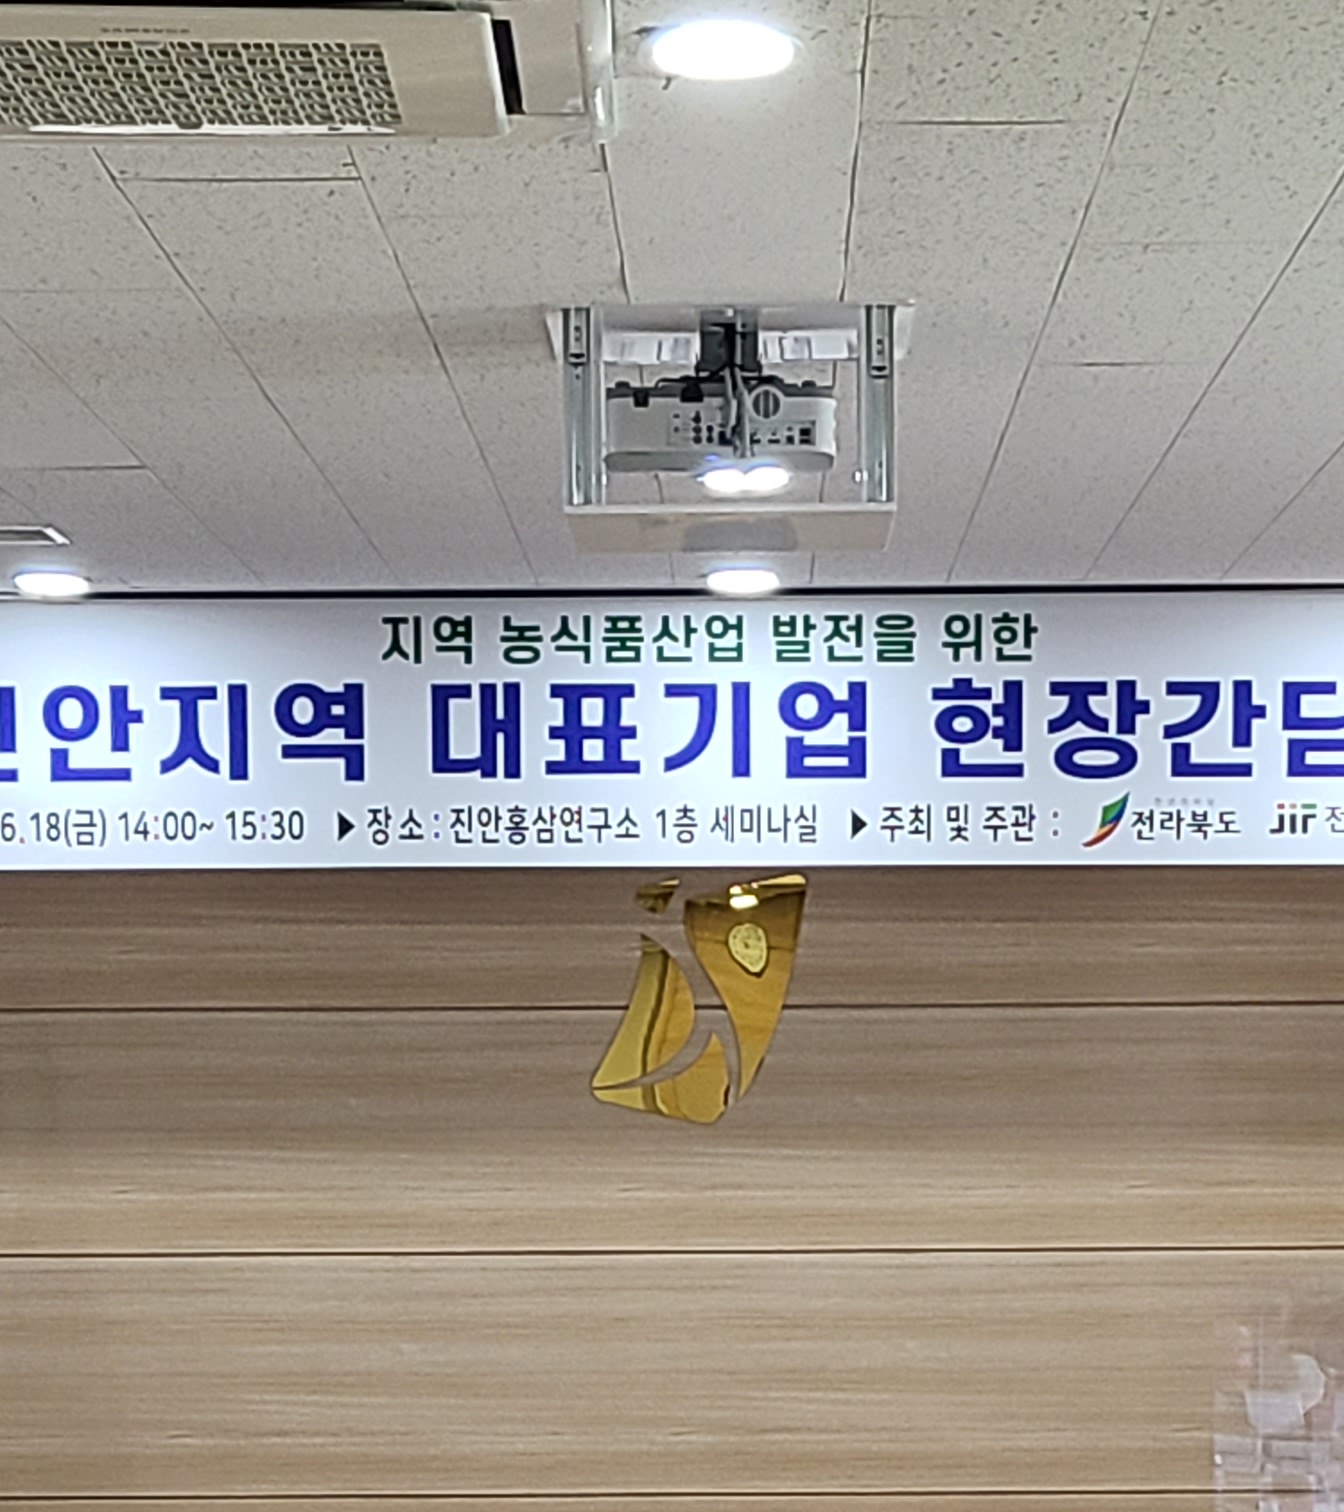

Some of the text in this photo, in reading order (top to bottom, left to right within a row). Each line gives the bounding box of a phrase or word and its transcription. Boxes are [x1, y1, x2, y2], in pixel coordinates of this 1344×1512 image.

[381, 611, 1039, 665] 지역 농식품산업 발전을 위한
[430, 680, 868, 780] 대표기업
[225, 810, 305, 842] 15:30
[449, 804, 641, 846] 진안홍삼연구소
[655, 803, 699, 844] 1층
[709, 803, 818, 844] 세미나실
[879, 803, 932, 844] 주최
[946, 803, 970, 843] 및
[982, 803, 1036, 843] 주관
[1130, 808, 1242, 841] 전라북도
